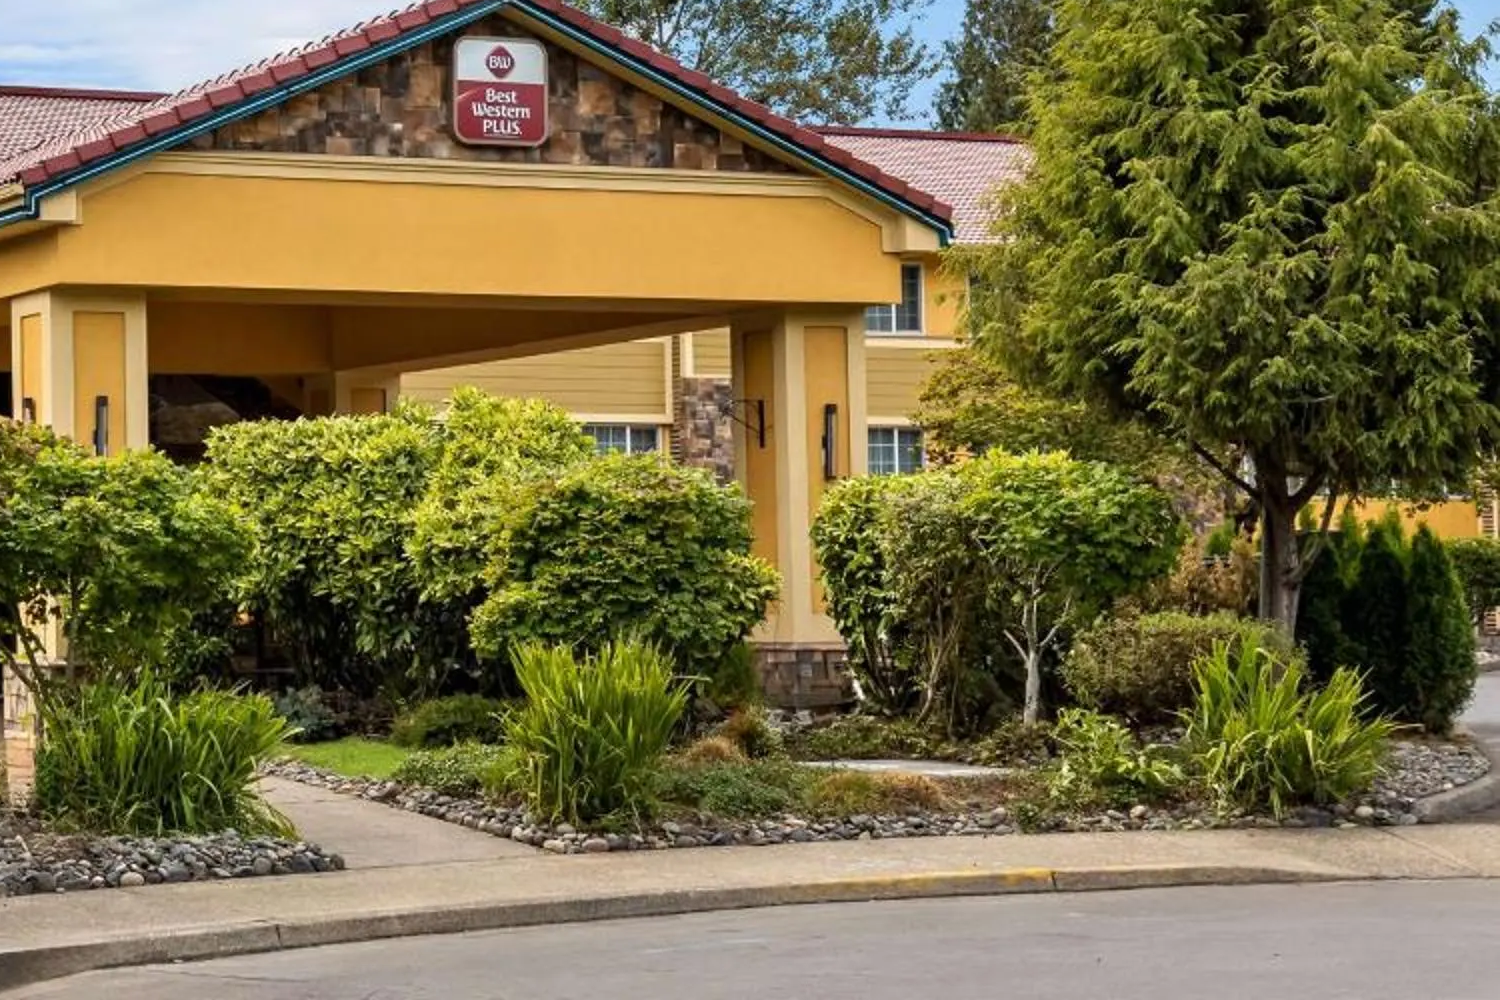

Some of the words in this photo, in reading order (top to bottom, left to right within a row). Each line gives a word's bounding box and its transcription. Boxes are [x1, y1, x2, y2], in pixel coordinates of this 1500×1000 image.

[485, 88, 517, 103] Best
[472, 102, 531, 119] Western
[483, 119, 521, 135] PLUS
